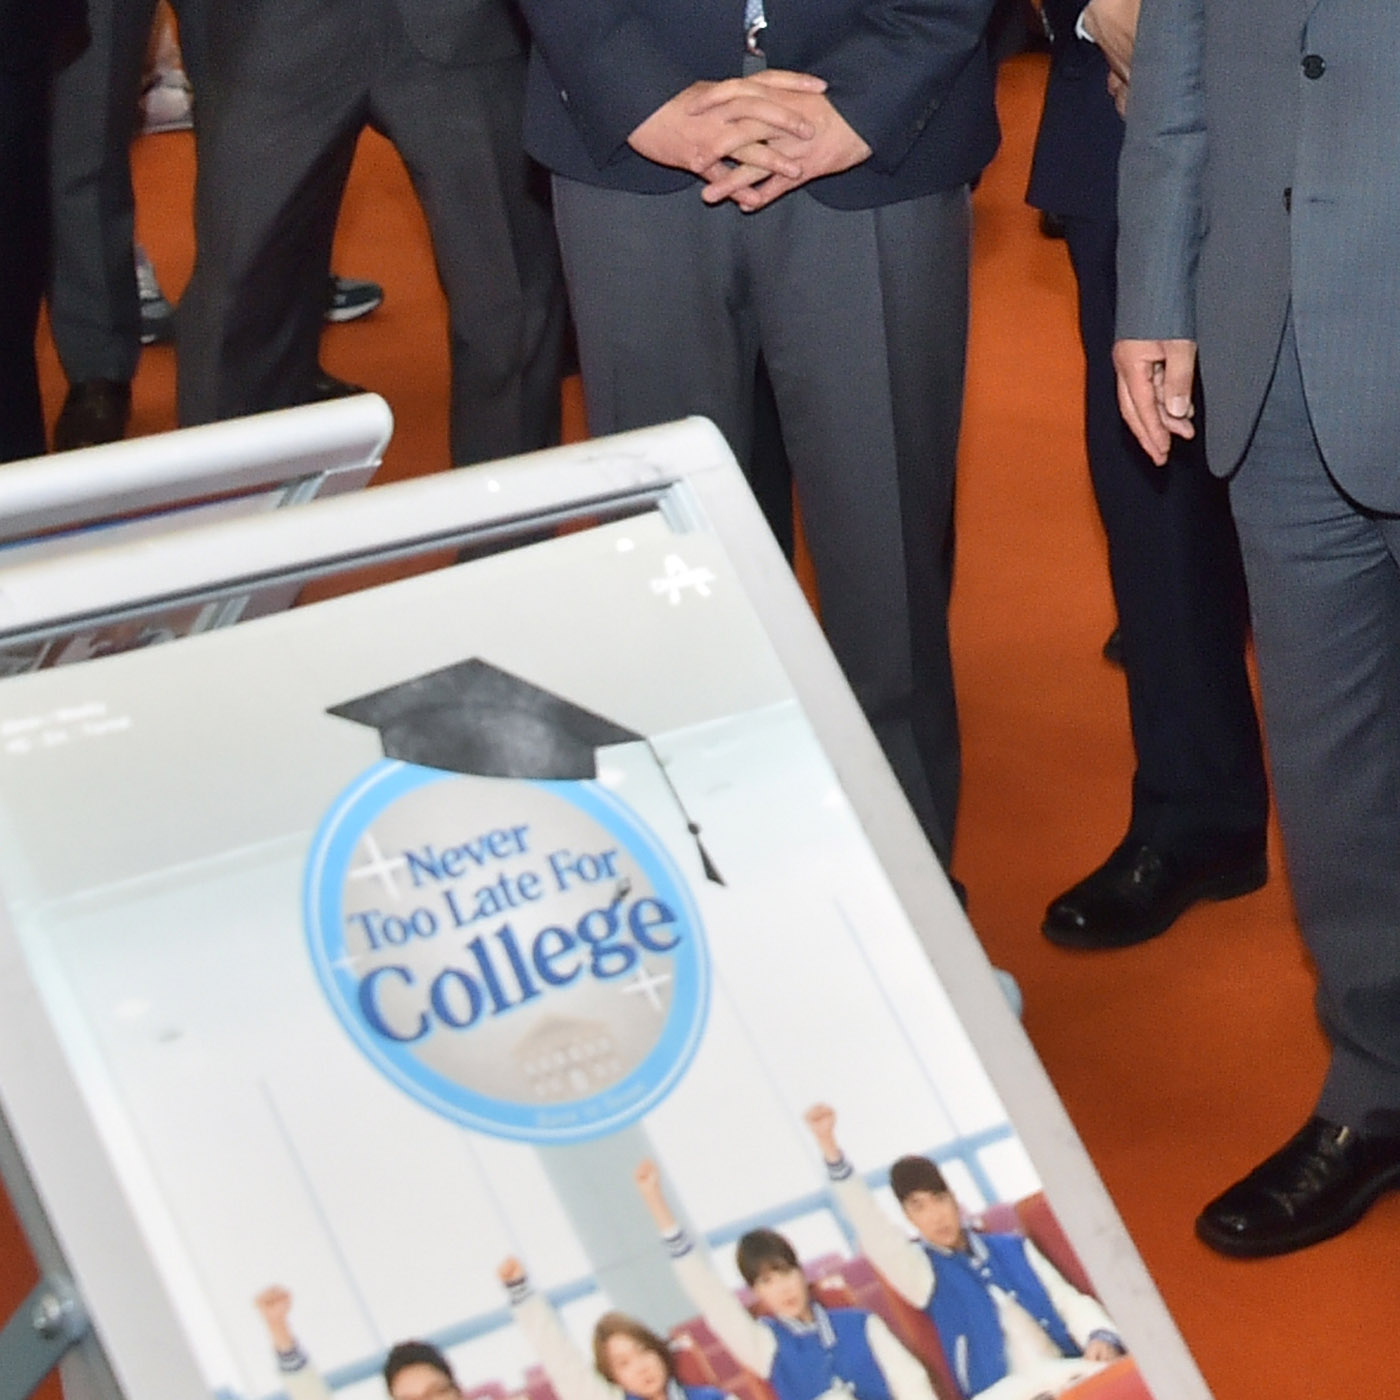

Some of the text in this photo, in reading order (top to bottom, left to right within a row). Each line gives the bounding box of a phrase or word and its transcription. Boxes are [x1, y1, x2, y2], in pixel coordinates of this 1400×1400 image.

[349, 847, 621, 951] Too Late For
[404, 823, 530, 887] Never
[357, 895, 684, 1044] College
